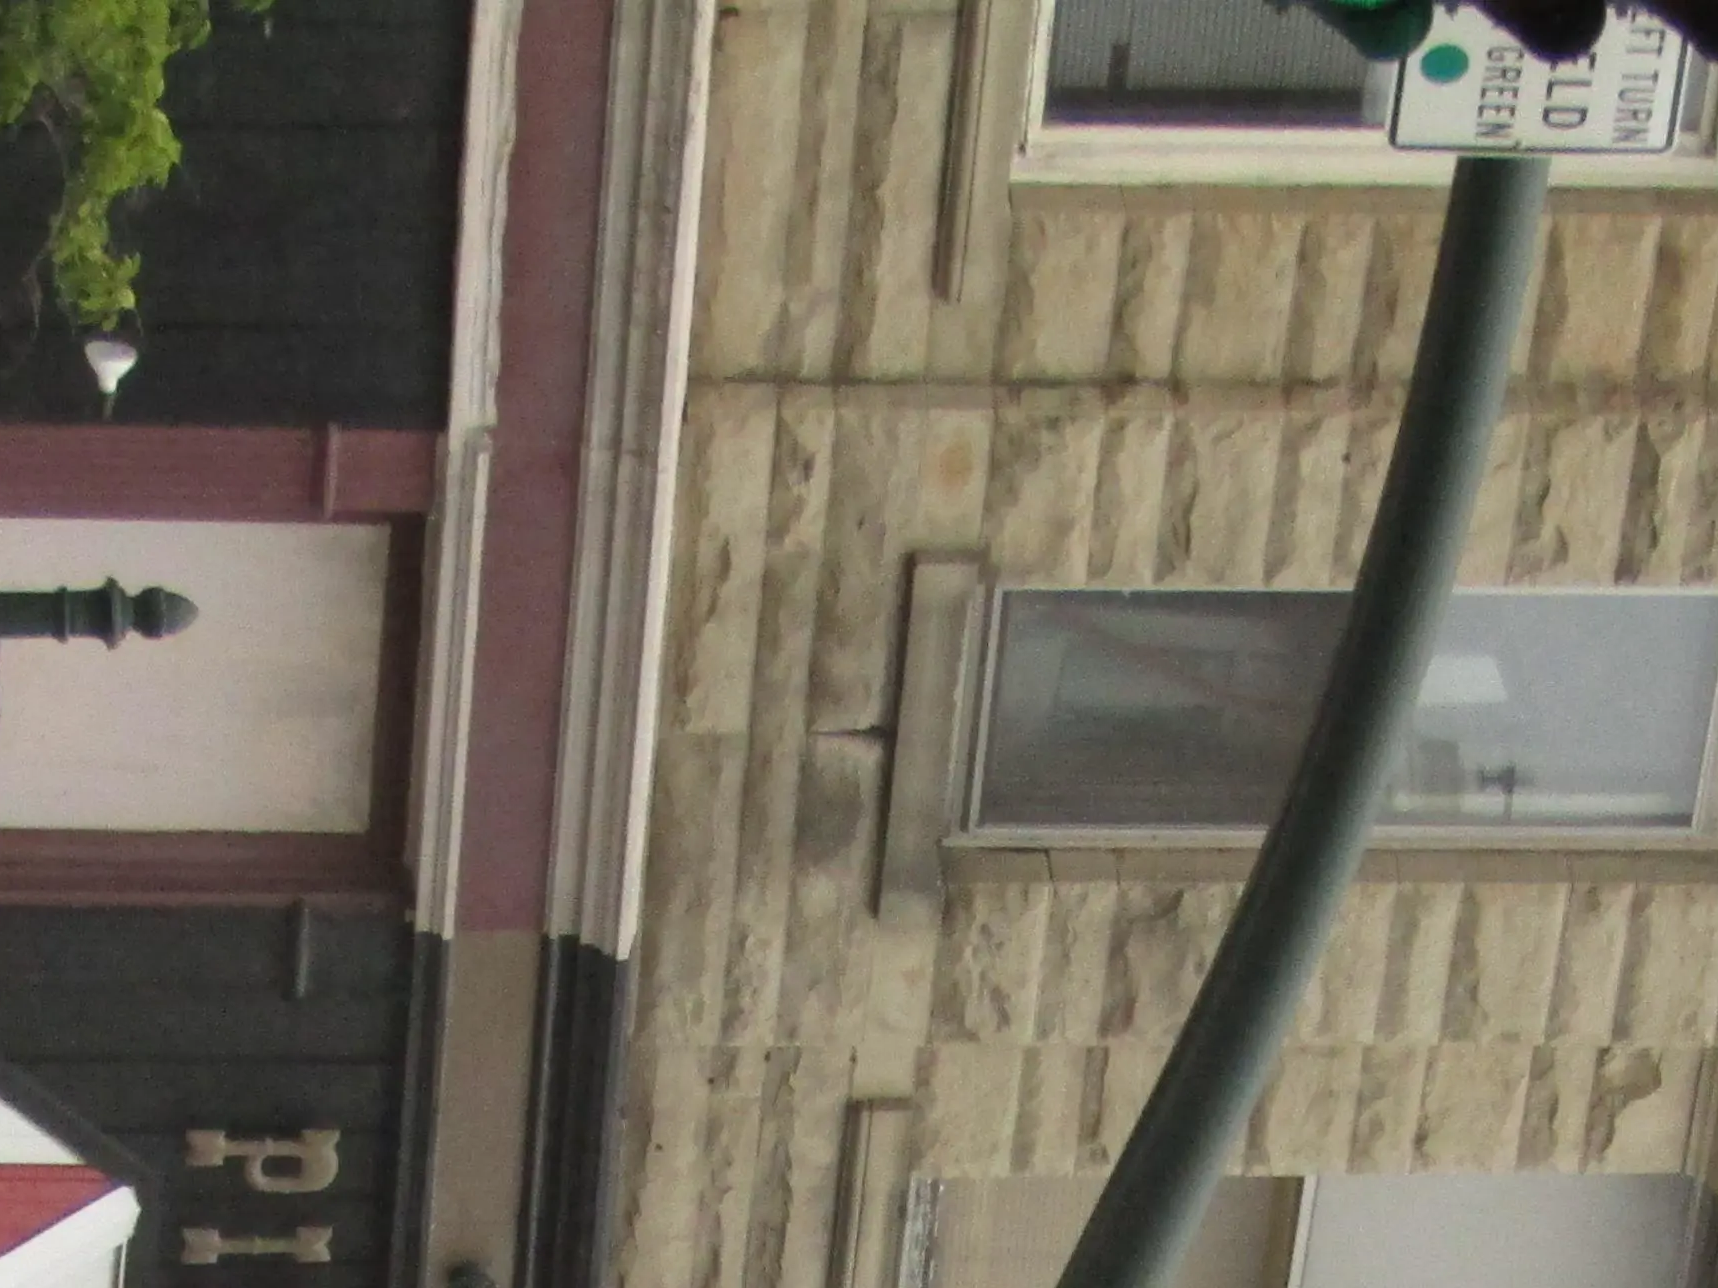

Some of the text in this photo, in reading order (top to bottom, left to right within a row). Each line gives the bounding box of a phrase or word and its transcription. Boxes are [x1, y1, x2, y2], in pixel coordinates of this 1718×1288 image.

[1475, 46, 1526, 139] GREEN
[1612, 12, 1666, 144] FT TURN
